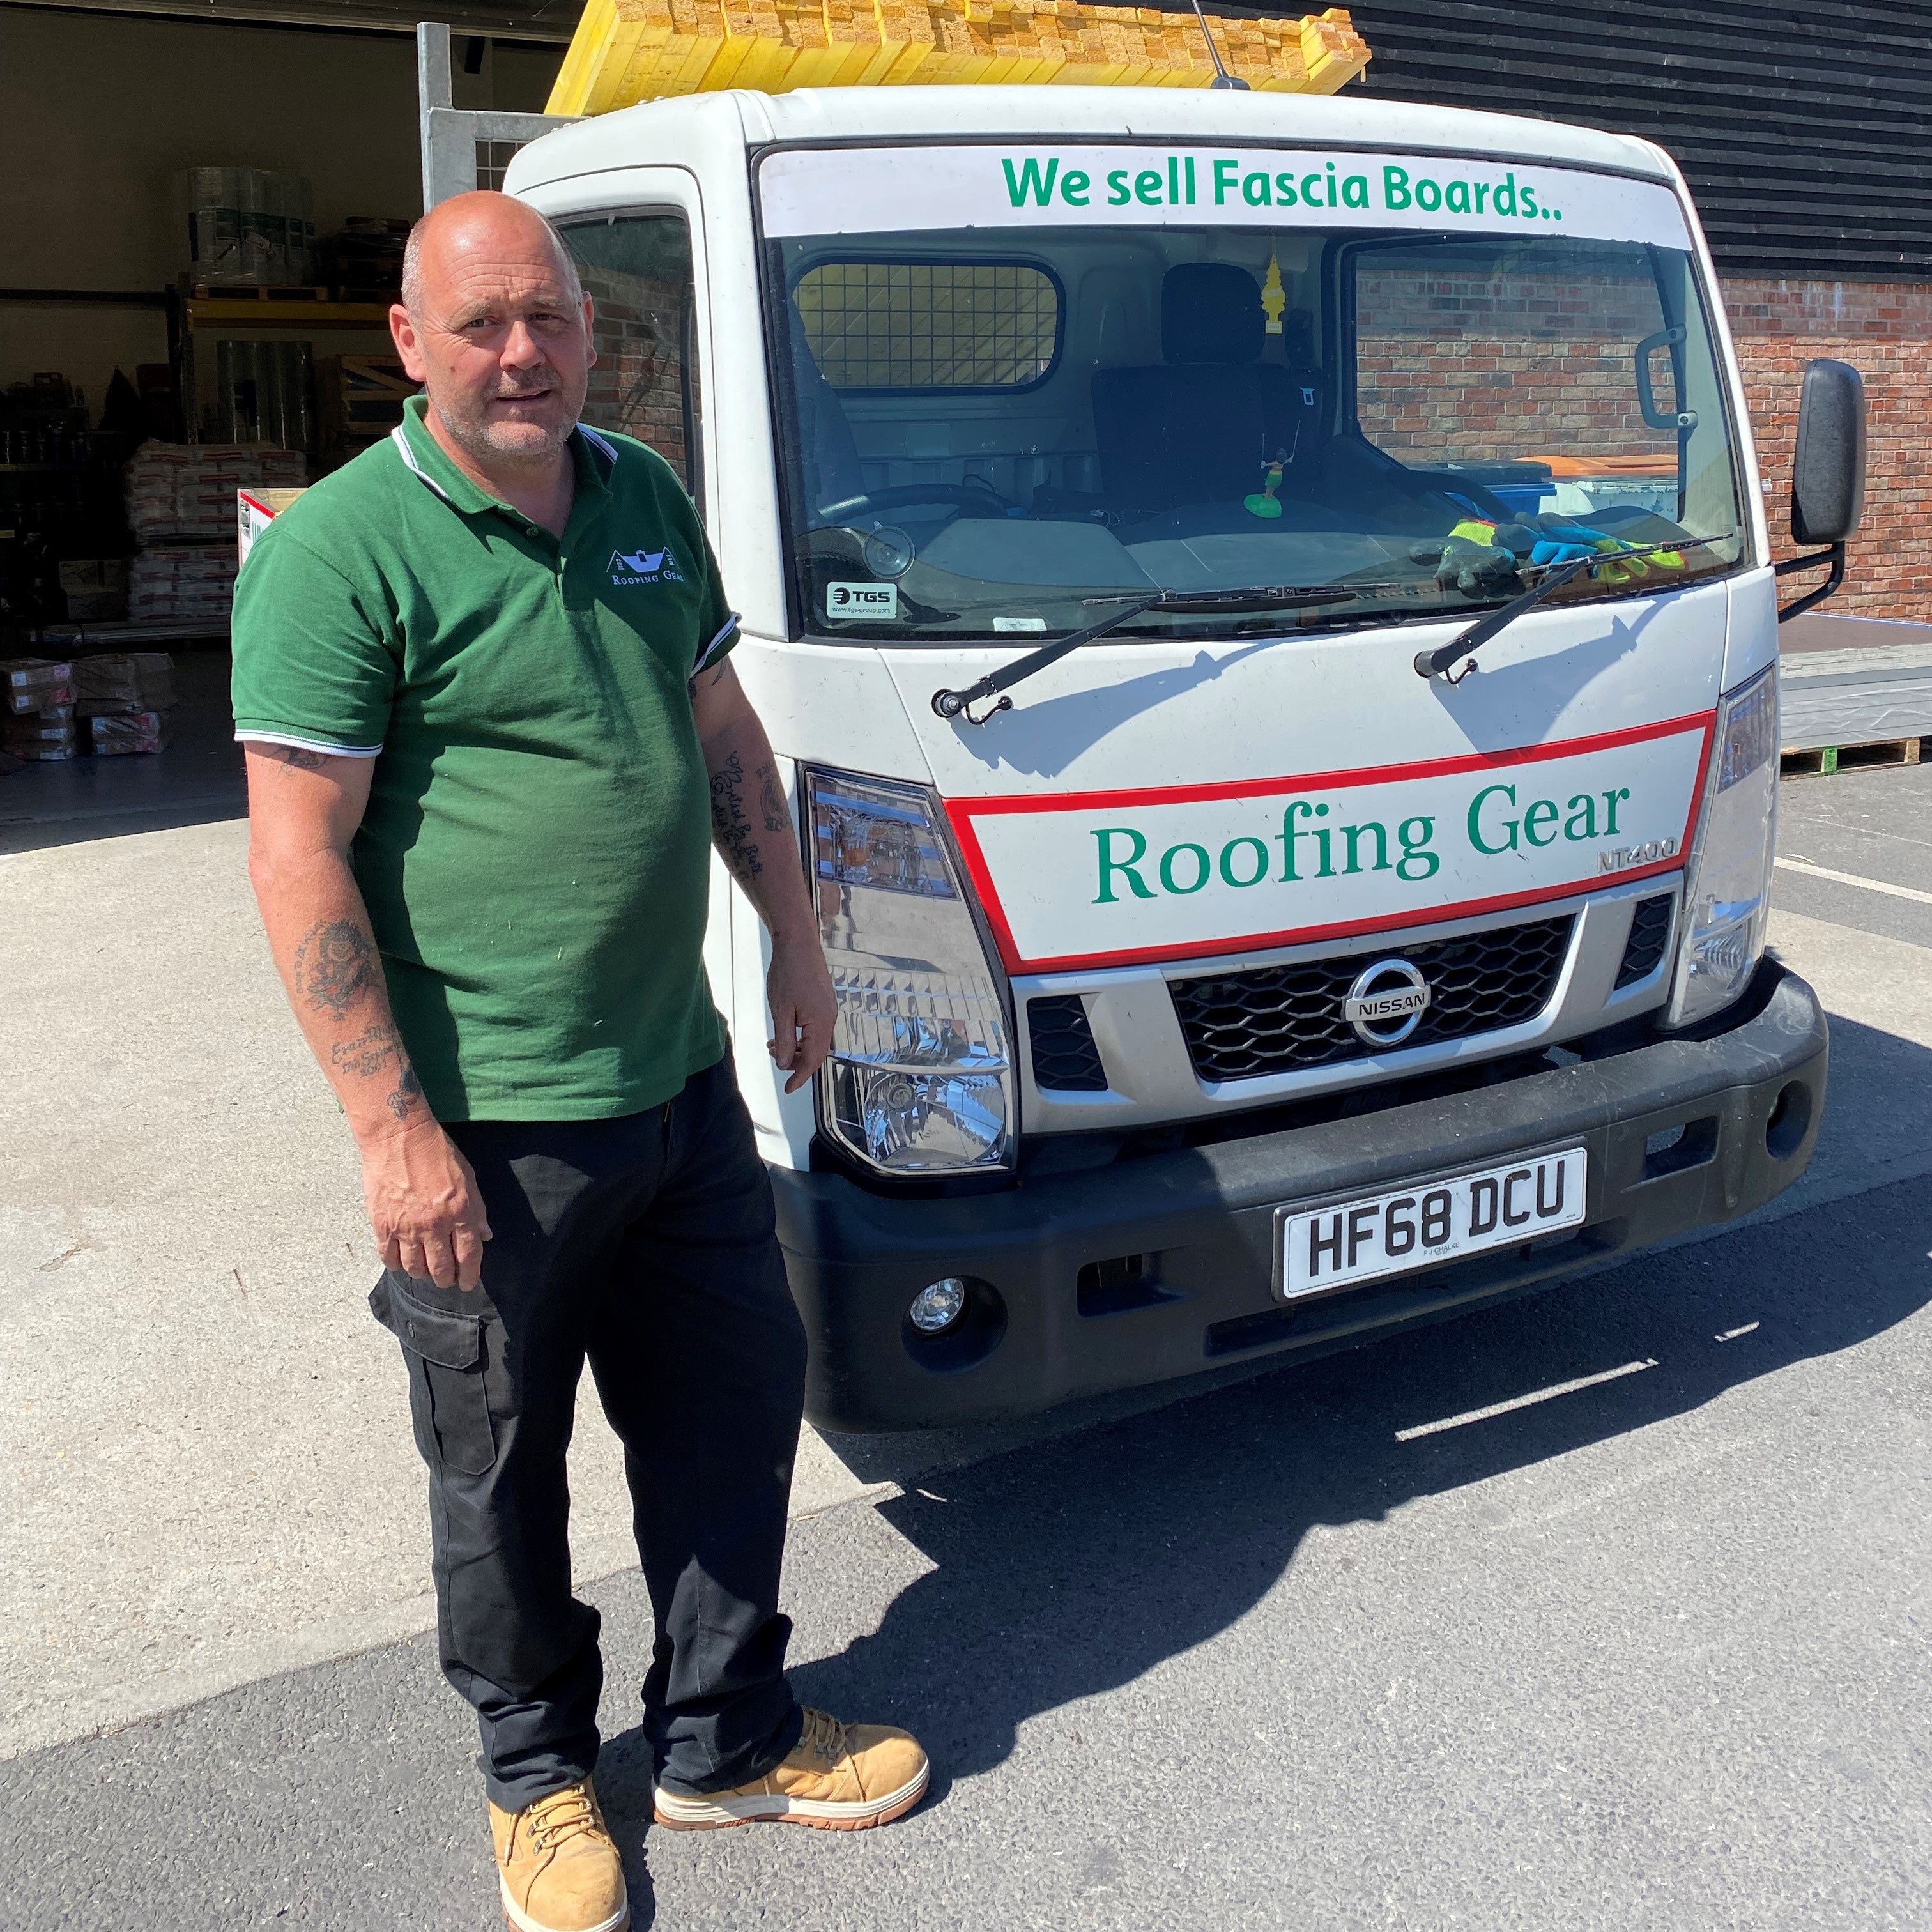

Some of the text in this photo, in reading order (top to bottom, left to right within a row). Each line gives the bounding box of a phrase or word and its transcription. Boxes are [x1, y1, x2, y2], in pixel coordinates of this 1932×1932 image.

[1001, 156, 1563, 221] We sell Fascia Boards..
[852, 590, 891, 603] TGS
[1089, 783, 1631, 905] Roofing Gear
[1597, 836, 1679, 874] NT400
[1359, 993, 1425, 1016] NISSAN
[1310, 1159, 1565, 1277] HF68 DCU
[1434, 1241, 1460, 1254] CHALKE
